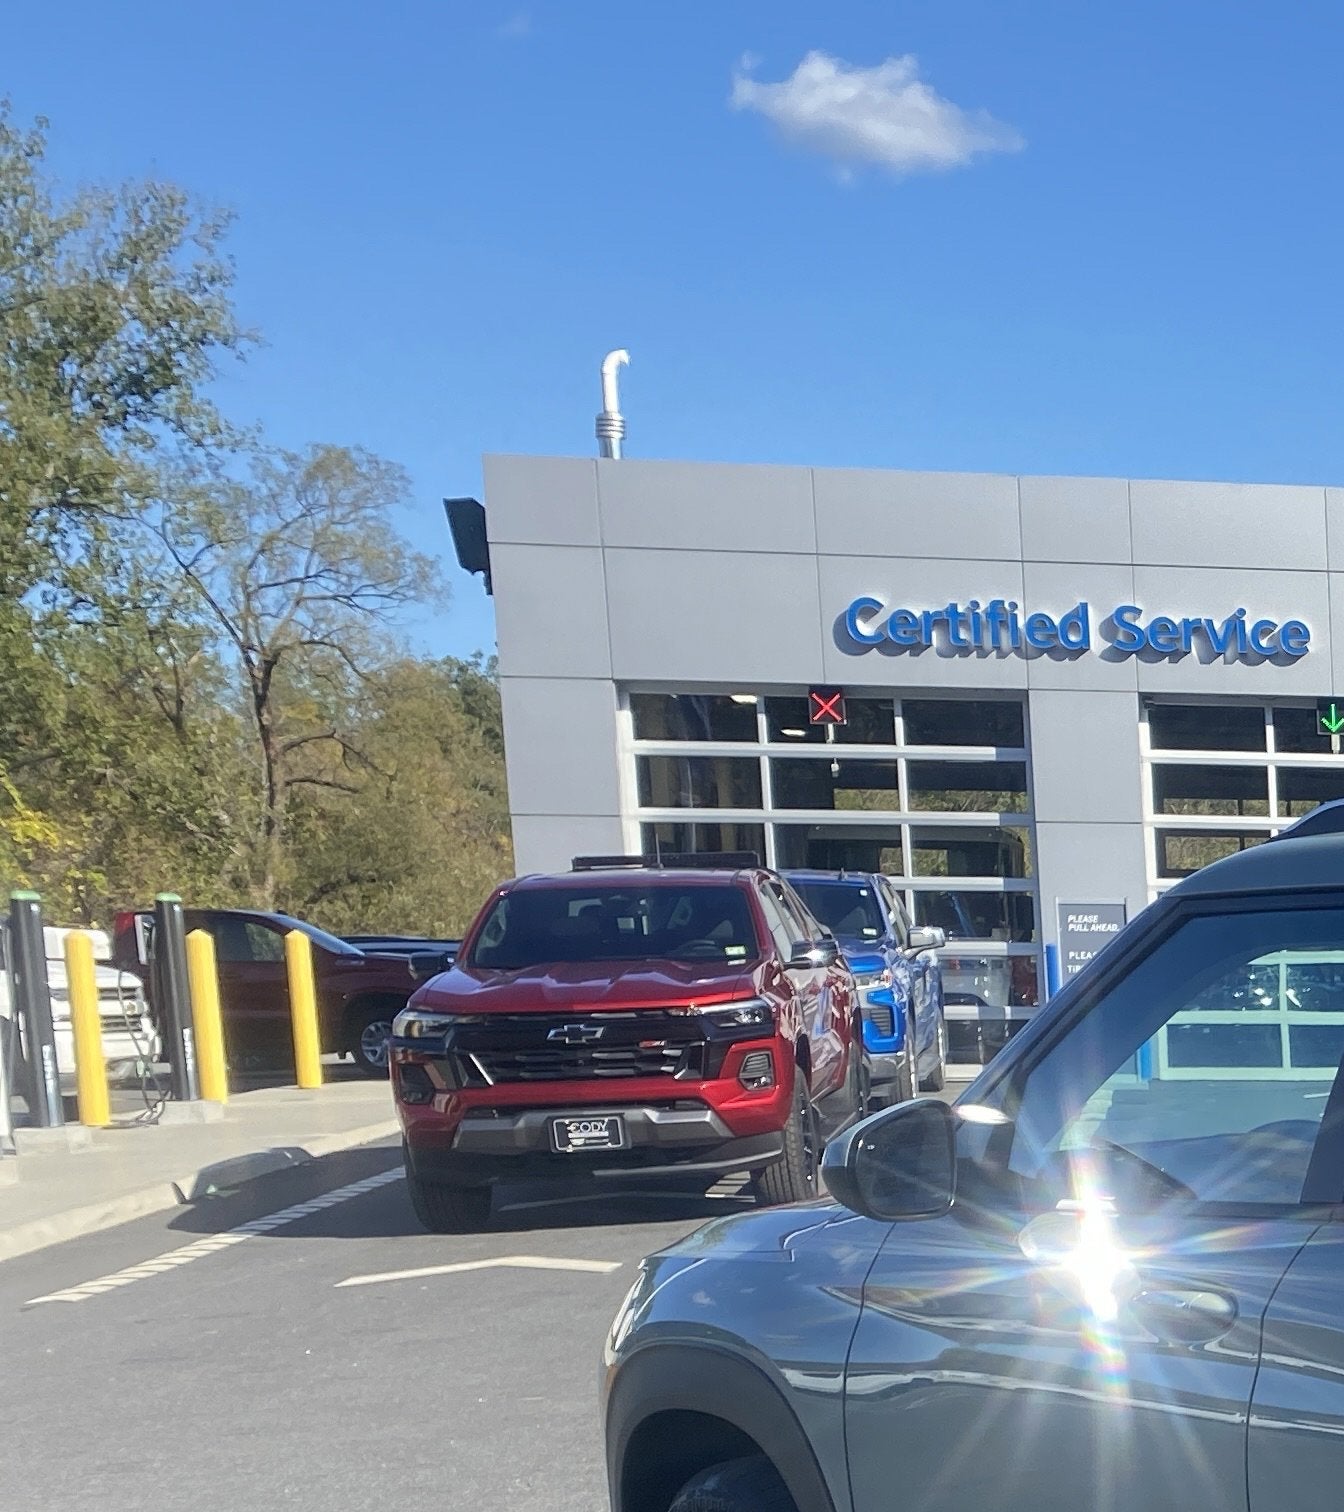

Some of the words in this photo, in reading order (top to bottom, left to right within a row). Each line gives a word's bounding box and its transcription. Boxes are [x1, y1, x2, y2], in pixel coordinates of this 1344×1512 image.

[845, 596, 1091, 651] Certified
[1112, 606, 1311, 656] Service
[1067, 915, 1099, 923] PLEASE
[1068, 924, 1089, 932] PULL
[1090, 923, 1120, 932] AHEAD.
[570, 1121, 608, 1132] CODY
